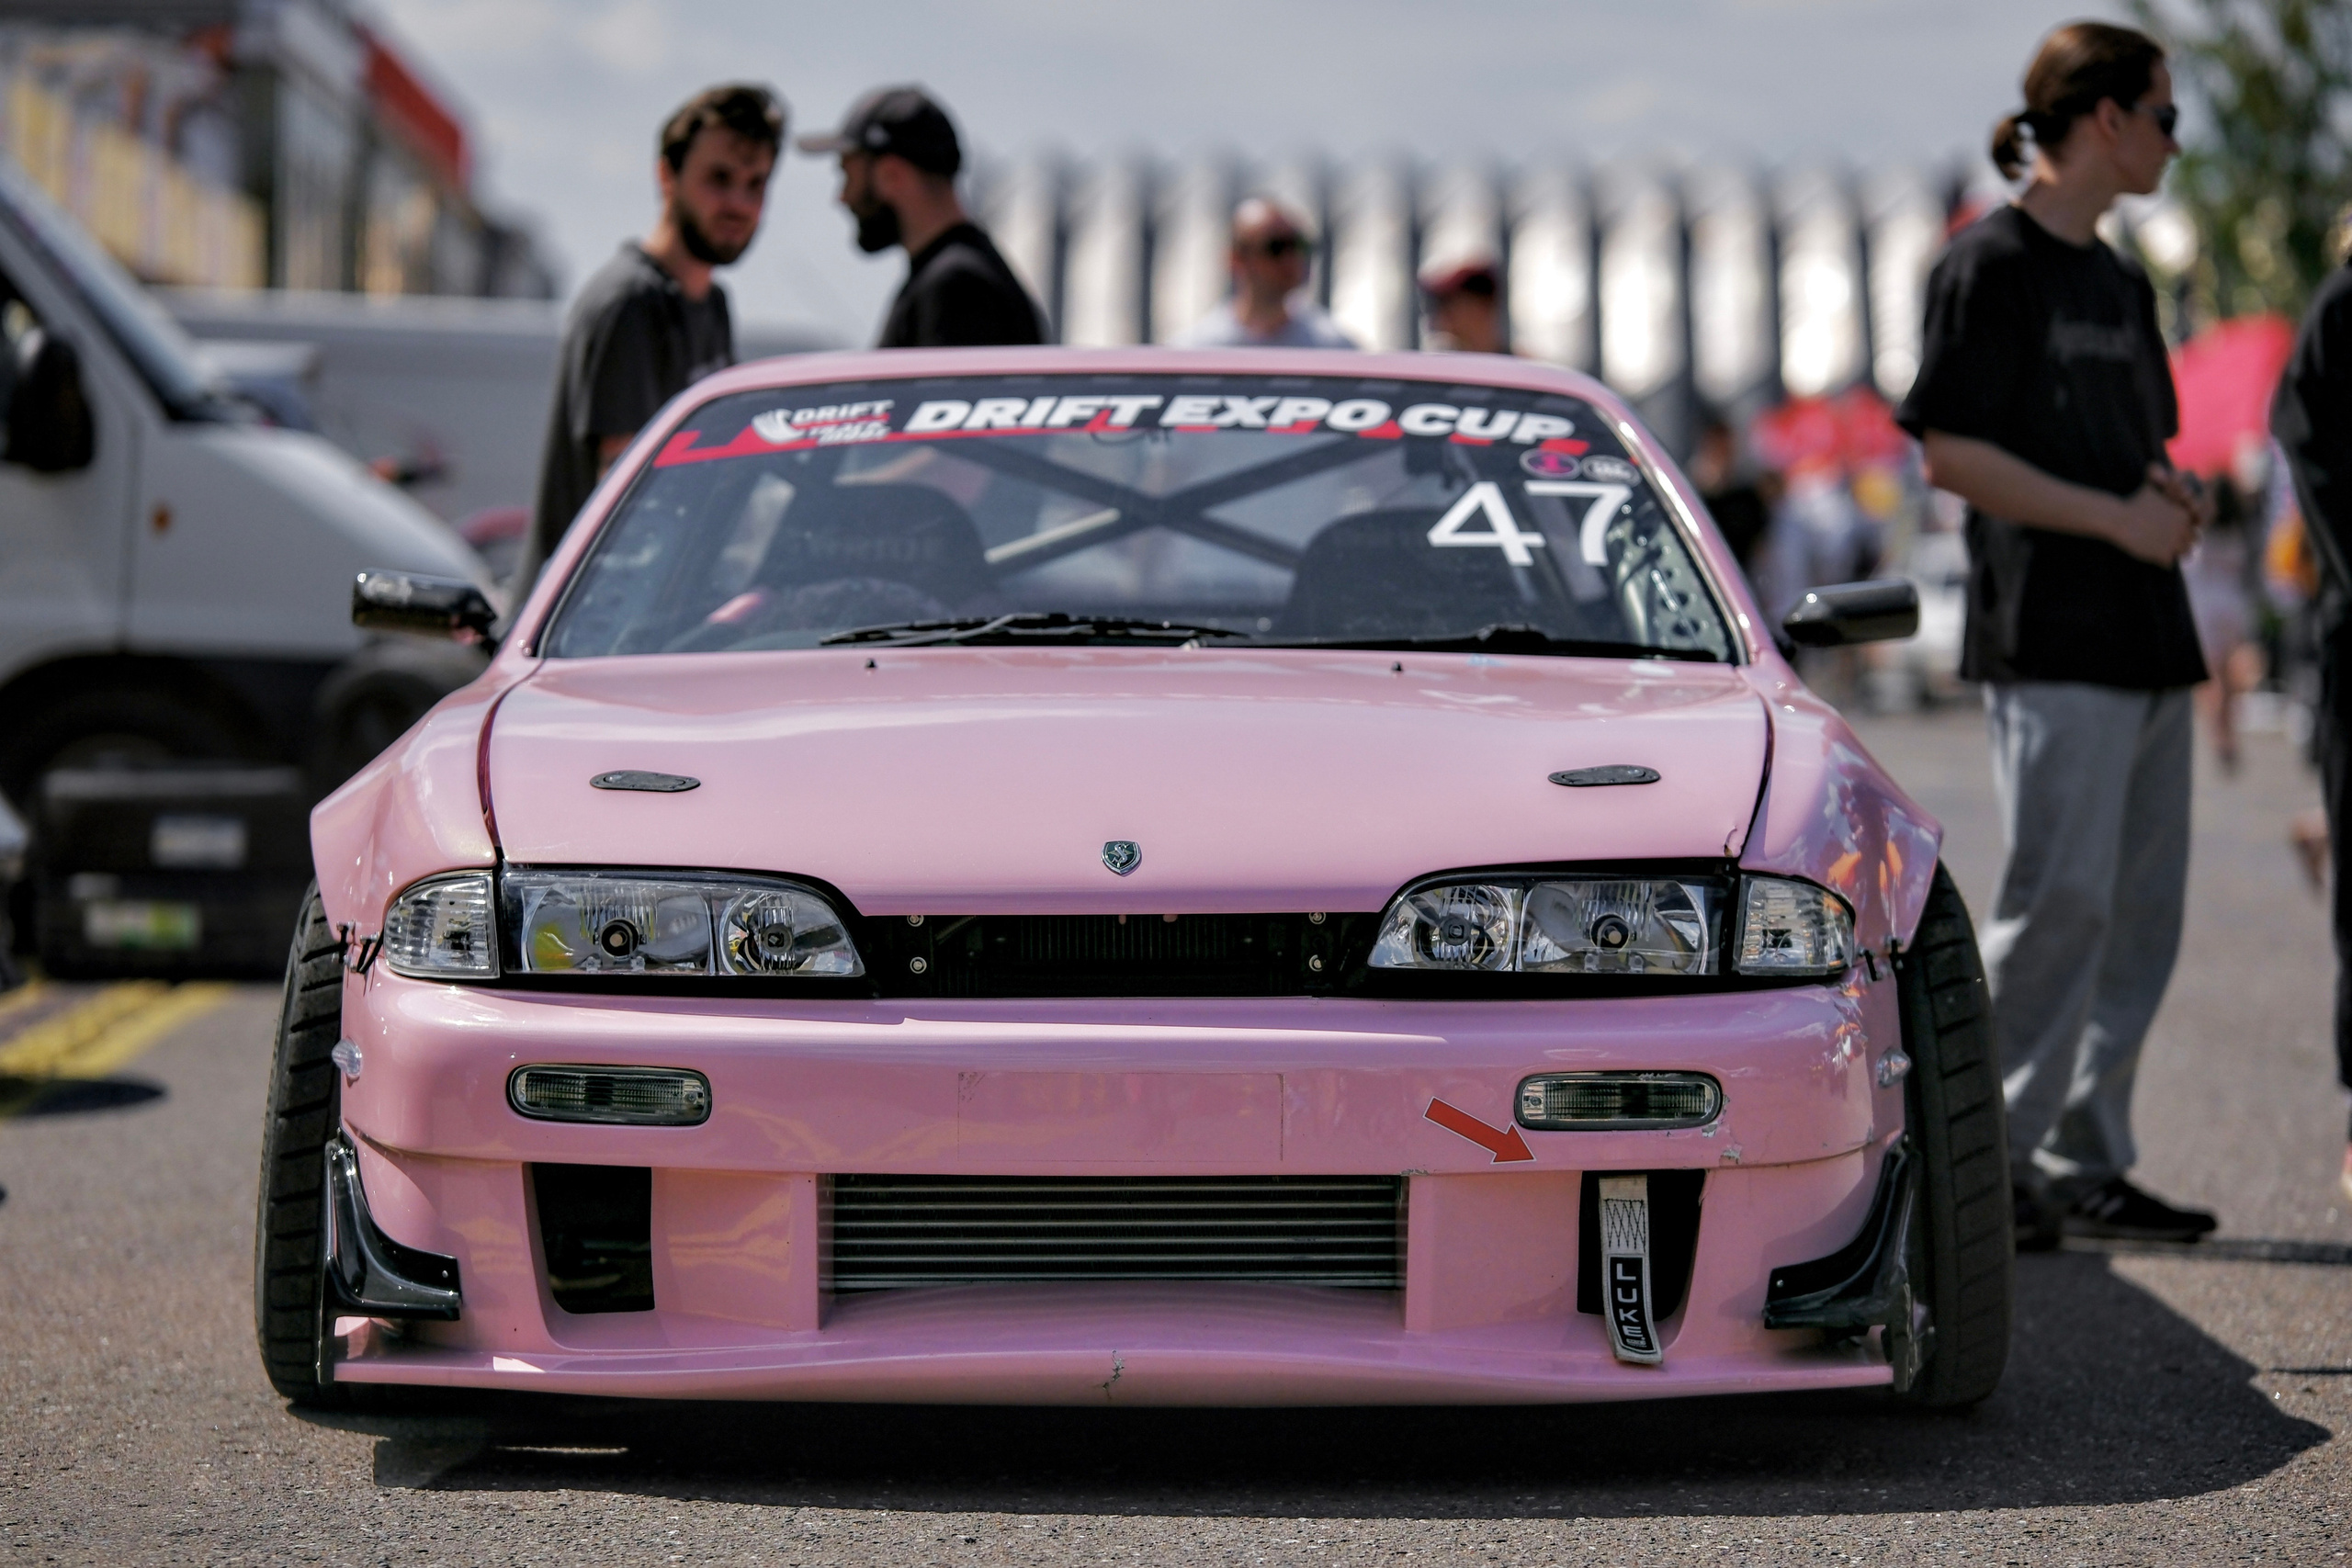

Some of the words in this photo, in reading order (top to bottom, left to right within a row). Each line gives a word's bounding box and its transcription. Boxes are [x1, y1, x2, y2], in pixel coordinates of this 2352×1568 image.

[790, 399, 896, 425] DRIFT
[902, 394, 1164, 432] DRIFT
[1158, 394, 1392, 432] EXPO
[1397, 402, 1576, 445] CUP
[1426, 479, 1634, 568] 47
[1616, 1262, 1644, 1337] LUKE
